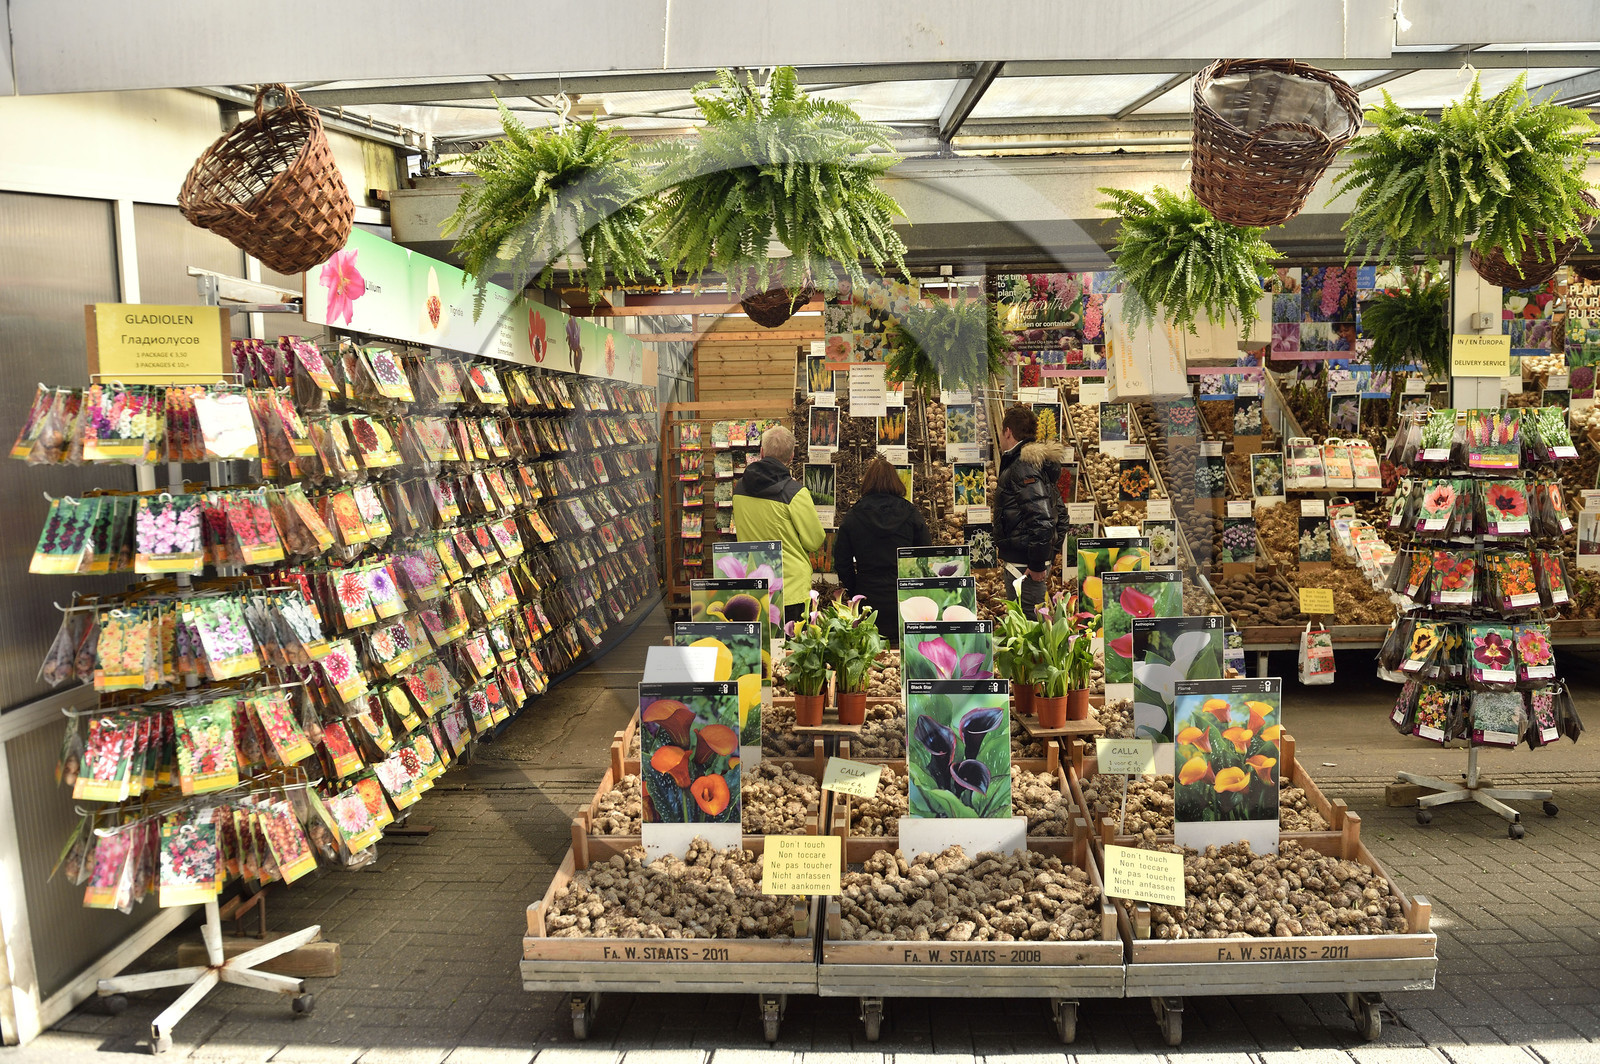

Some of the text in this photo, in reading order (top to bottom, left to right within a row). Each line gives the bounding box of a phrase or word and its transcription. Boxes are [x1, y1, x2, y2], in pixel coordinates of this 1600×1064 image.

[1570, 298, 1599, 307] YOUR
[125, 314, 193, 324] GLADIOLEN
[1569, 310, 1600, 318] BULBS
[121, 334, 200, 346] Гладиолусов
[840, 768, 865, 777] CALLA
[1121, 851, 1167, 863] Don't touch
[1140, 863, 1168, 872] toccare
[1146, 873, 1176, 882] toucher
[1114, 877, 1175, 892] Nicht anfassen
[1135, 890, 1176, 901] aankomen
[625, 947, 640, 959] W.
[644, 947, 688, 960] STAATS
[702, 948, 728, 960] 2011
[929, 950, 942, 962] W.
[950, 950, 996, 962] STAATS
[1011, 950, 1041, 962] 2008
[1240, 948, 1255, 960] W.
[1260, 946, 1307, 960] STAATS
[1321, 946, 1349, 958] 2011
